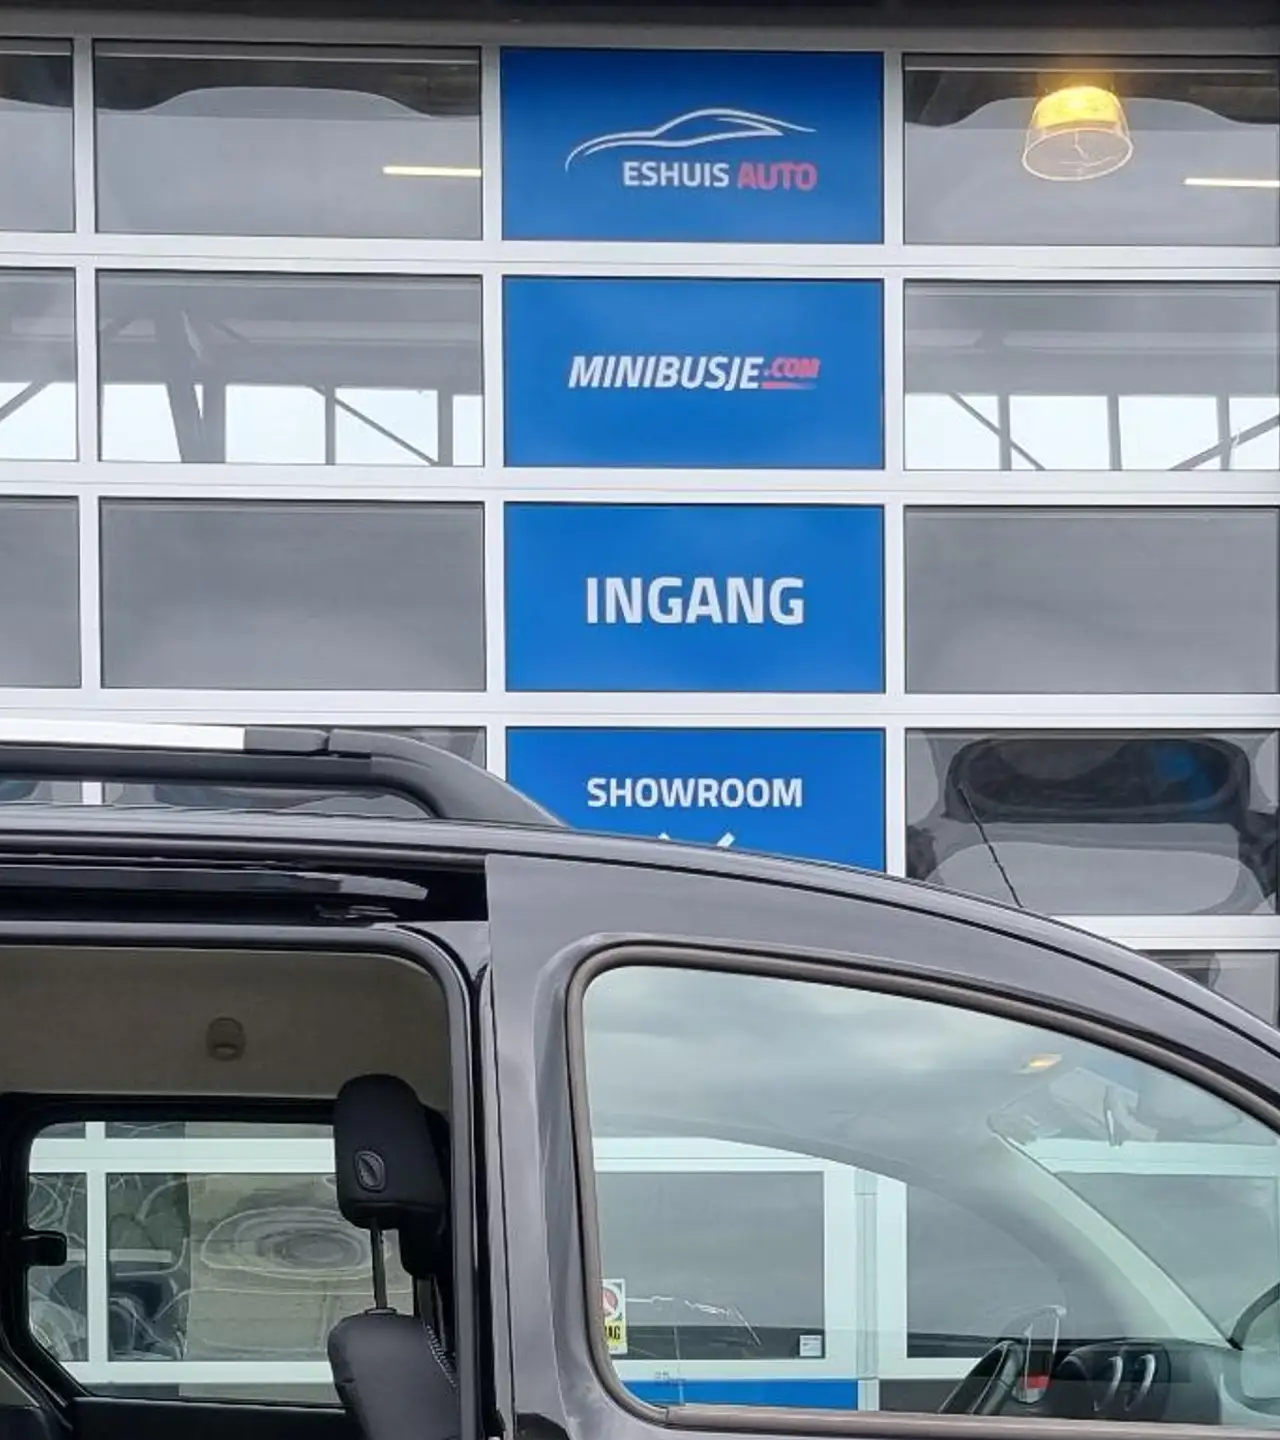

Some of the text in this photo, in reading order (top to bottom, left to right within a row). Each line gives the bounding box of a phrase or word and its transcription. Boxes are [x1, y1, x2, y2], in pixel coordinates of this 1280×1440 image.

[622, 160, 818, 191] ESHUIS AUTO
[567, 355, 821, 391] MINIBUSJE.COM
[586, 576, 806, 626] INGANG
[586, 777, 804, 808] SHOWROOM
[604, 1325, 621, 1340] AG
